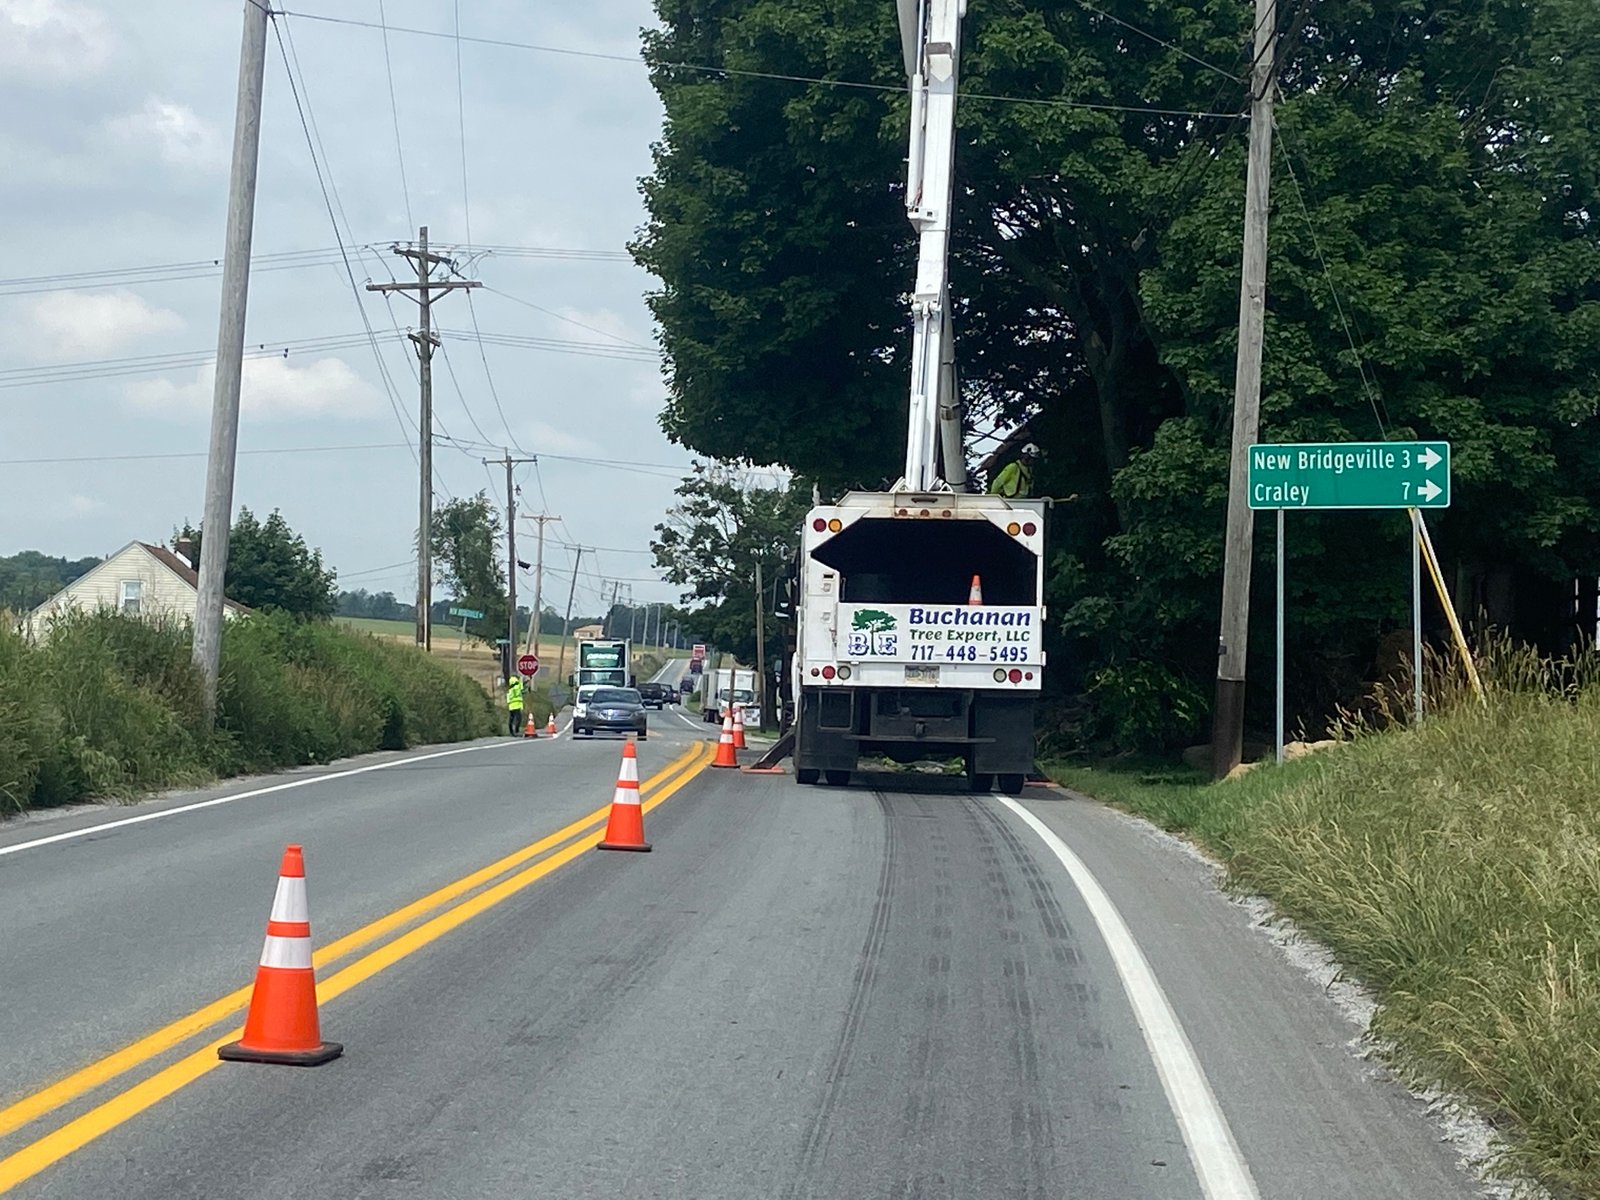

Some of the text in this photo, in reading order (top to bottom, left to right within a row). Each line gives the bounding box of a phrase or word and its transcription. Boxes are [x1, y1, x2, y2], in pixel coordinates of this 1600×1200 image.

[1254, 448, 1411, 474] New Bridgeville 3
[1254, 482, 1411, 506] Craley 7
[909, 608, 1031, 627] Buchanan
[909, 629, 1031, 643] Tree Expert, LLC
[911, 645, 1028, 662] 717-448-5495
[519, 661, 538, 670] STOP
